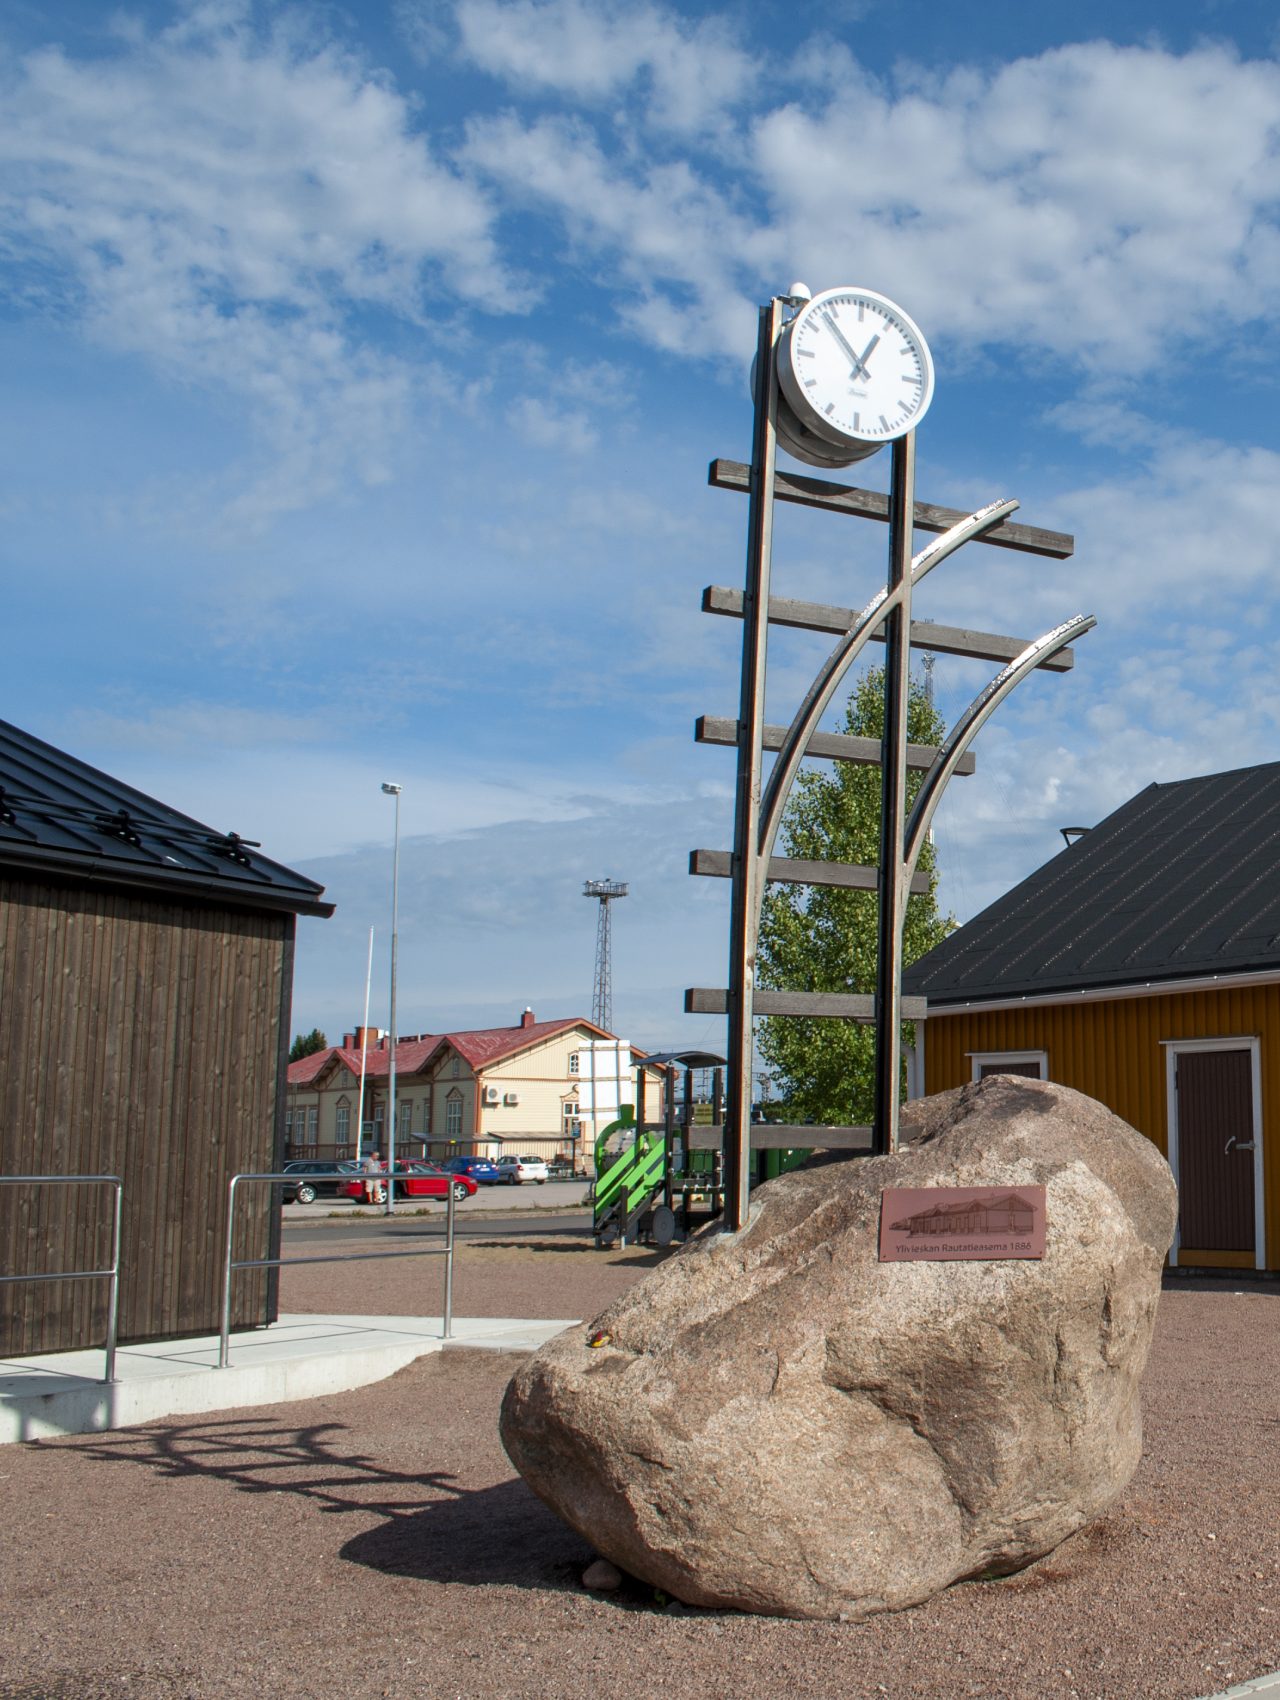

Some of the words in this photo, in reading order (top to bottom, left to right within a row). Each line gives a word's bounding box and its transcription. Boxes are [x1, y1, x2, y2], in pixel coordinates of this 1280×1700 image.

[896, 1244, 940, 1254] Ylivieskan
[942, 1243, 1007, 1252] Rautatieasema
[1010, 1242, 1032, 1251] 1886
